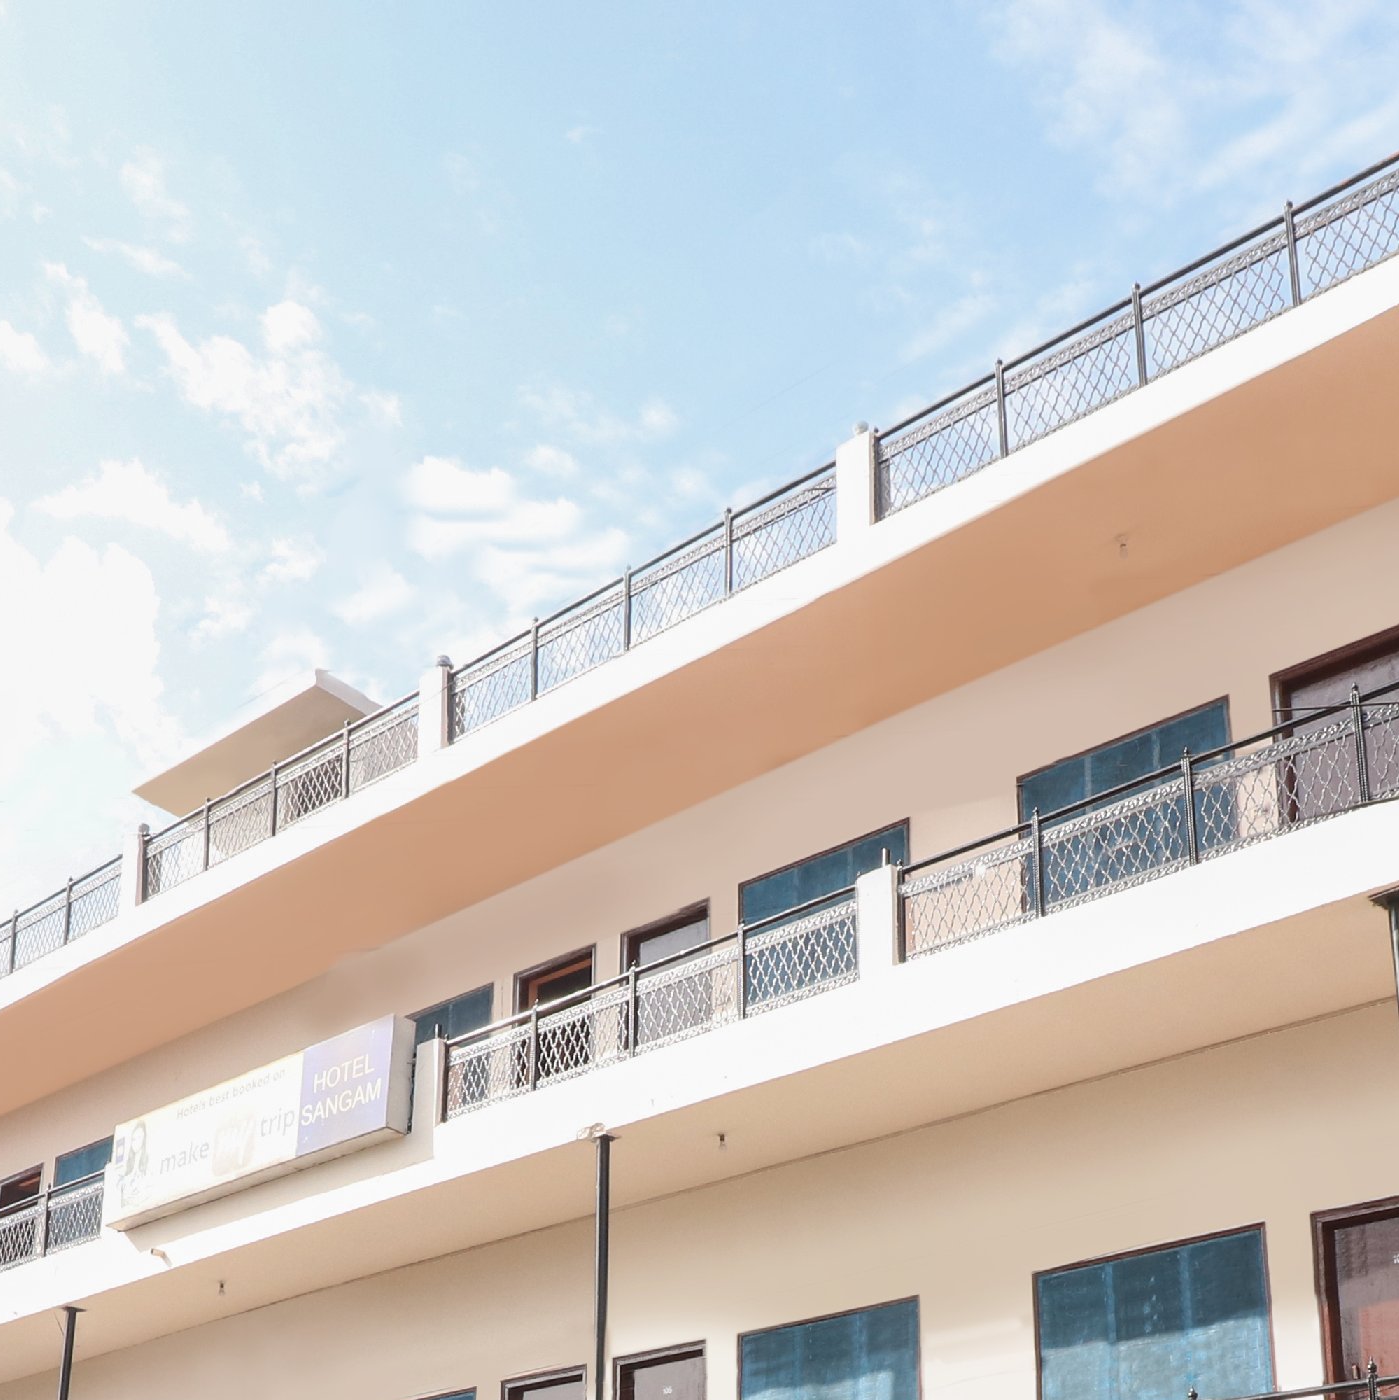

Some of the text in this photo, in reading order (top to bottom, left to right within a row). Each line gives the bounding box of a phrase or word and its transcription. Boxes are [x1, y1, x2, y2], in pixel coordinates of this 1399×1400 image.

[209, 1090, 229, 1106] best
[232, 1075, 270, 1098] booked
[272, 1069, 286, 1082] on
[313, 1053, 375, 1092] HOTEL
[300, 1077, 382, 1127] SANGAM
[159, 1140, 209, 1175] make
[260, 1108, 295, 1138] trip
